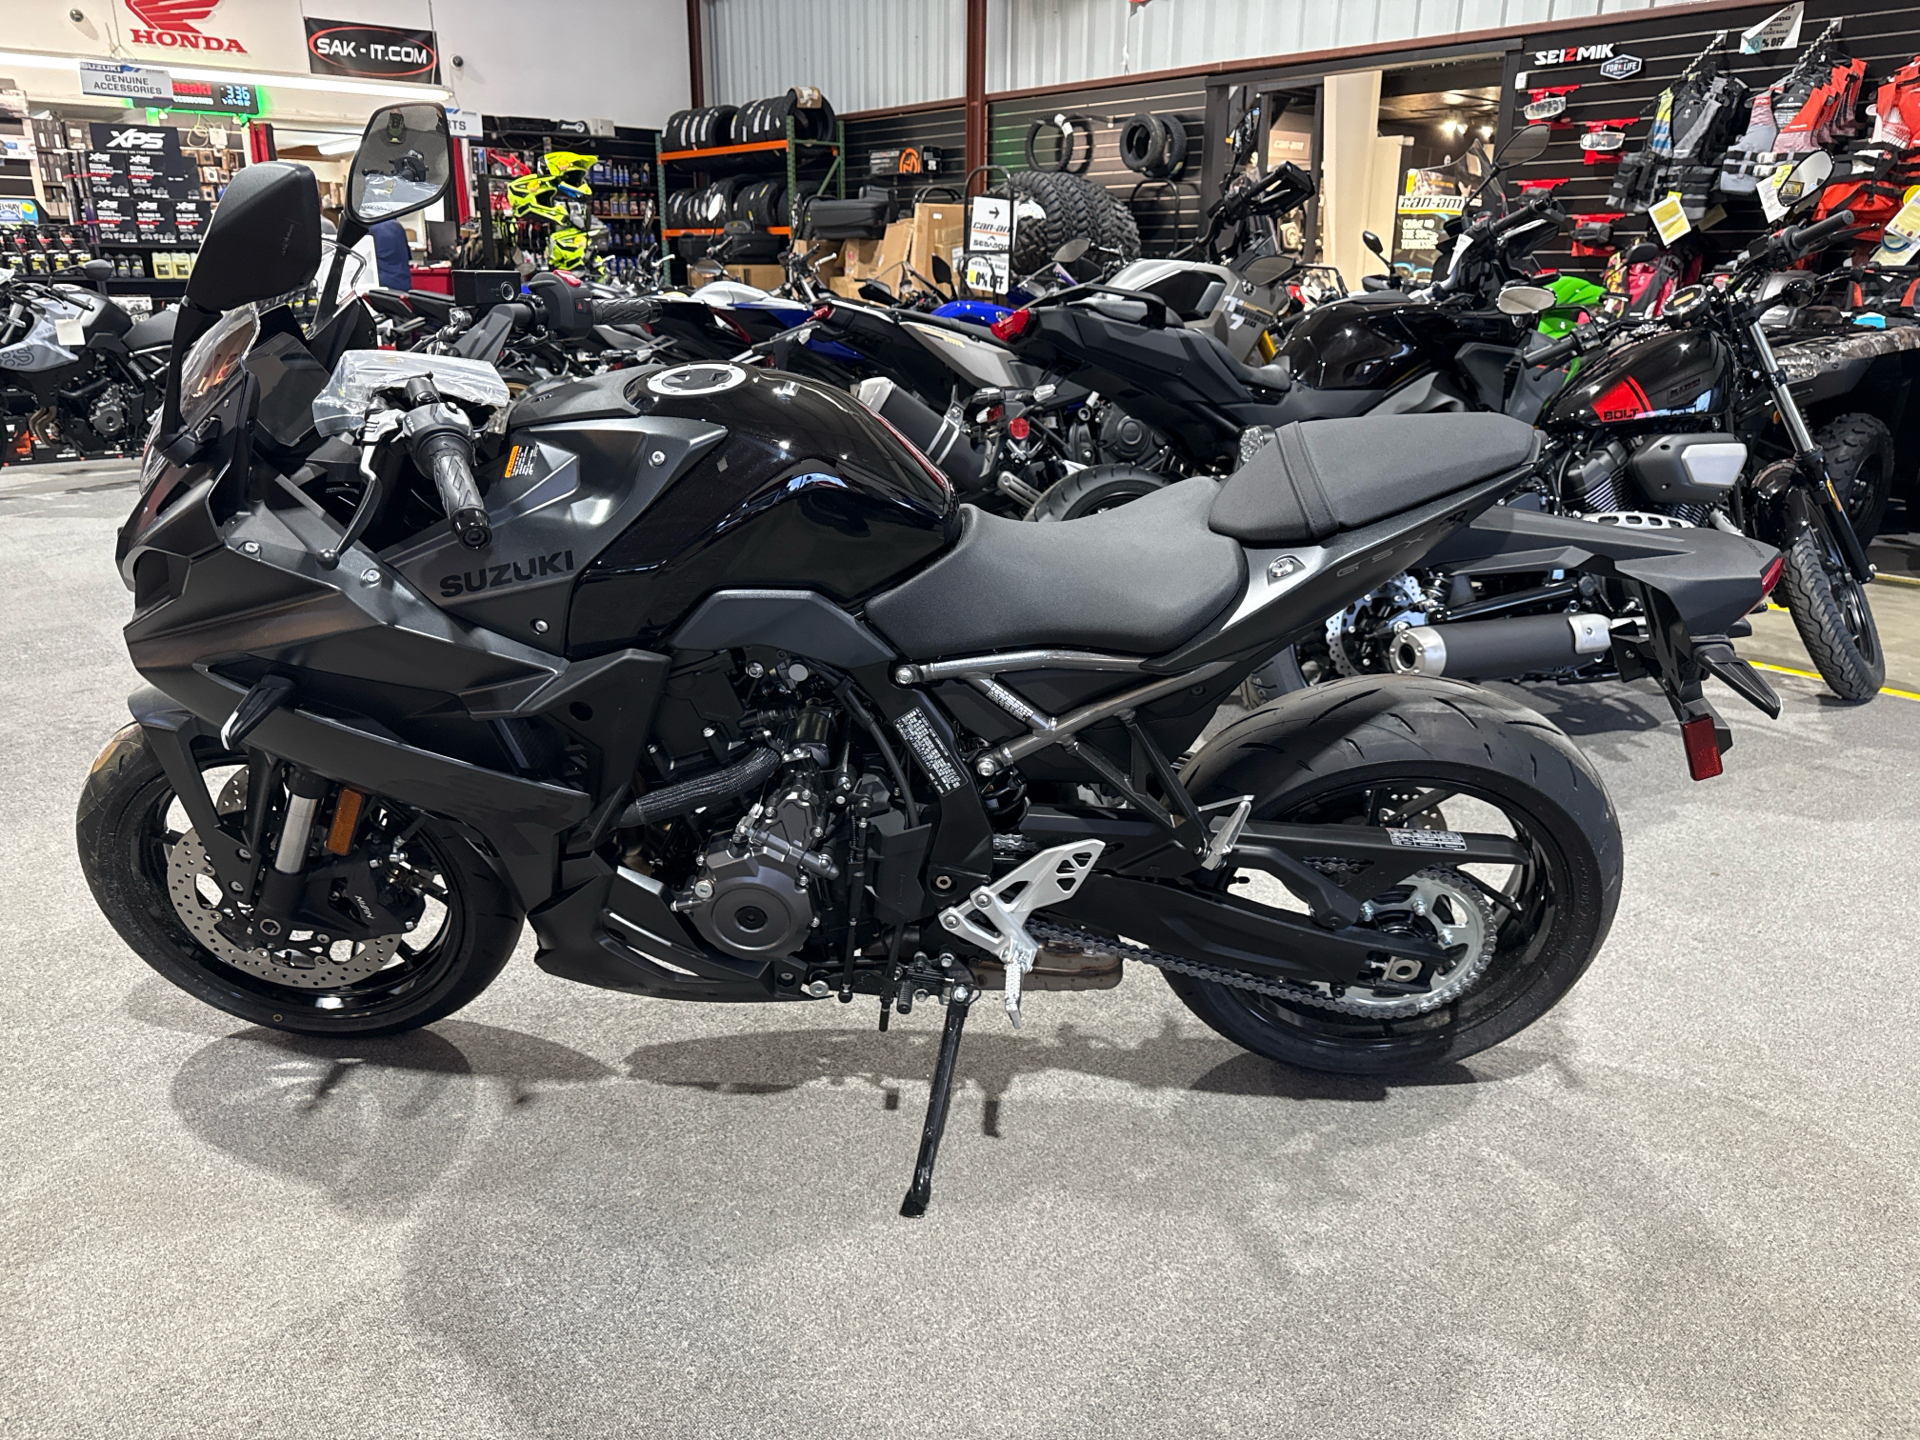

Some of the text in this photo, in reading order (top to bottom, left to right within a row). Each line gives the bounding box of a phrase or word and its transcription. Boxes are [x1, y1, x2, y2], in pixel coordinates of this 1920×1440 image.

[129, 28, 248, 53] HONDA
[316, 38, 357, 58] SAK
[370, 43, 427, 65] IT.COM
[1534, 43, 1615, 66] SEIZMIK
[80, 62, 121, 72] SUZUKI
[1605, 61, 1637, 73] FOR LIFE
[104, 74, 149, 86] GENUINE
[93, 82, 162, 95] ACCESSORIES
[106, 128, 166, 149] XPS
[1400, 197, 1462, 209] can-am
[1603, 408, 1639, 420] BOLT
[439, 550, 574, 598] SUZUKI
